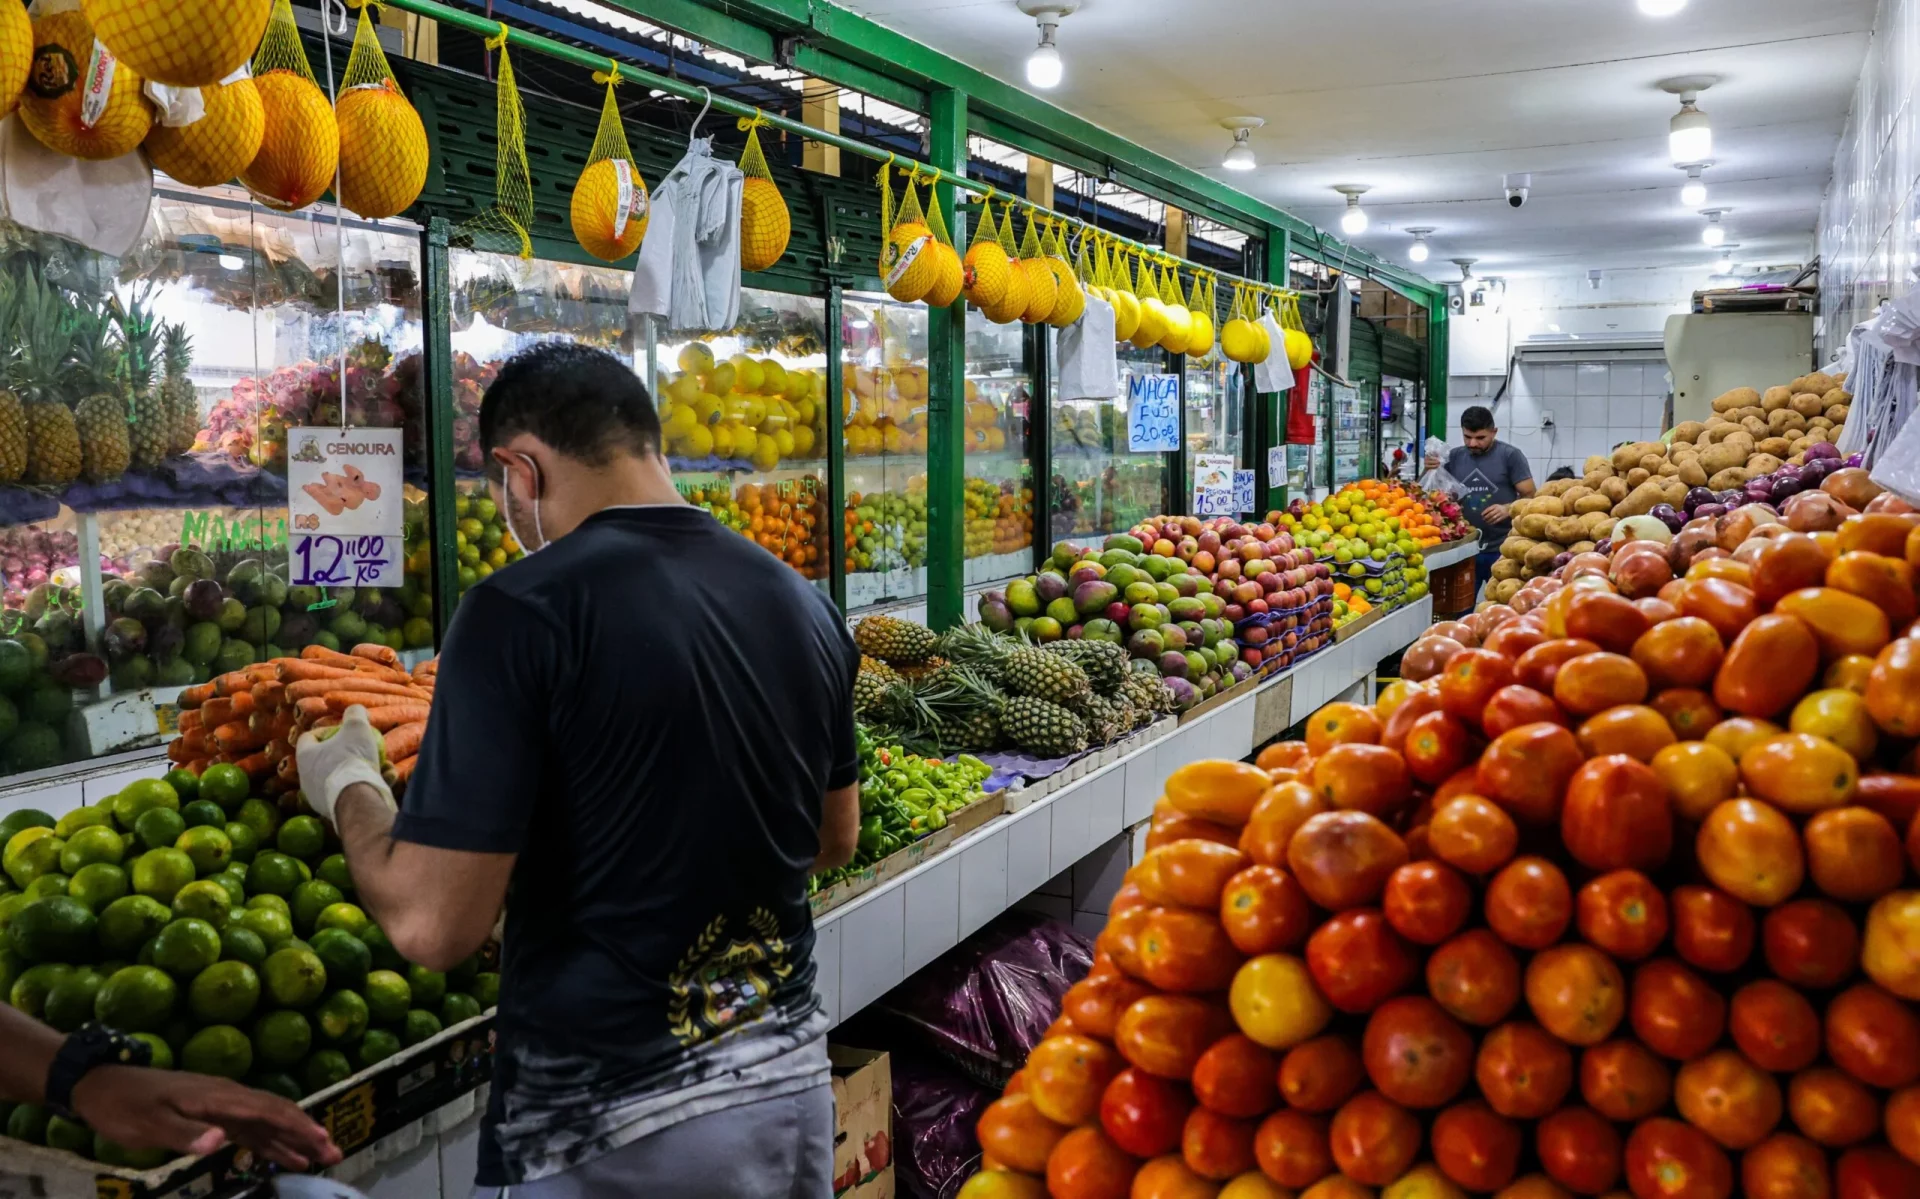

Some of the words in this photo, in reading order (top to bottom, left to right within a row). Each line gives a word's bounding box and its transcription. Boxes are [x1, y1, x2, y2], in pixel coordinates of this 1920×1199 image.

[1128, 375, 1177, 405] MAÇÃ
[326, 443, 395, 455] CENOURA
[295, 513, 320, 531] R$
[355, 563, 380, 587] KG
